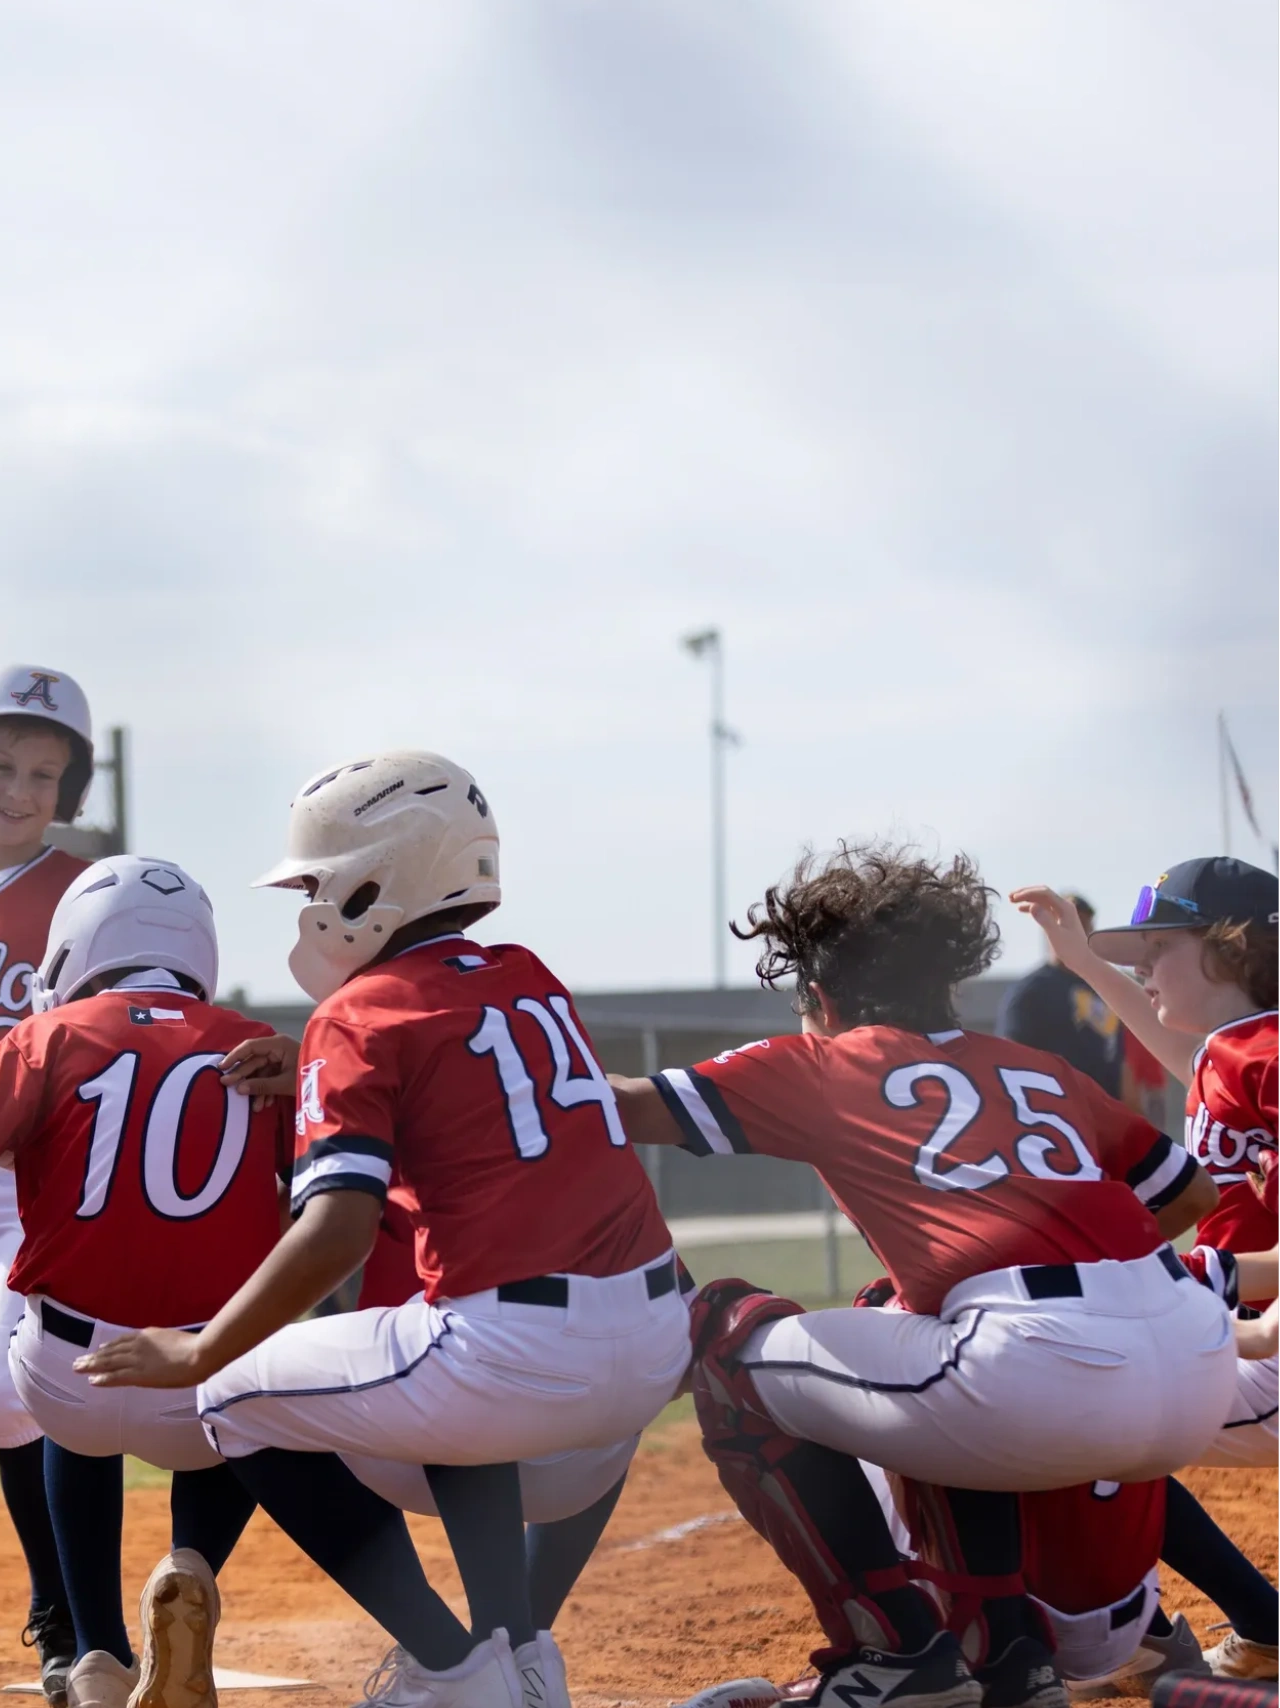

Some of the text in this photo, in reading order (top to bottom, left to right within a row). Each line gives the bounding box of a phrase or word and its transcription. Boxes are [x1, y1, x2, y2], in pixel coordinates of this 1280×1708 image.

[10, 671, 60, 712] A
[74, 1049, 251, 1222] 10
[465, 995, 627, 1162] 14
[880, 1061, 1104, 1192] 25
